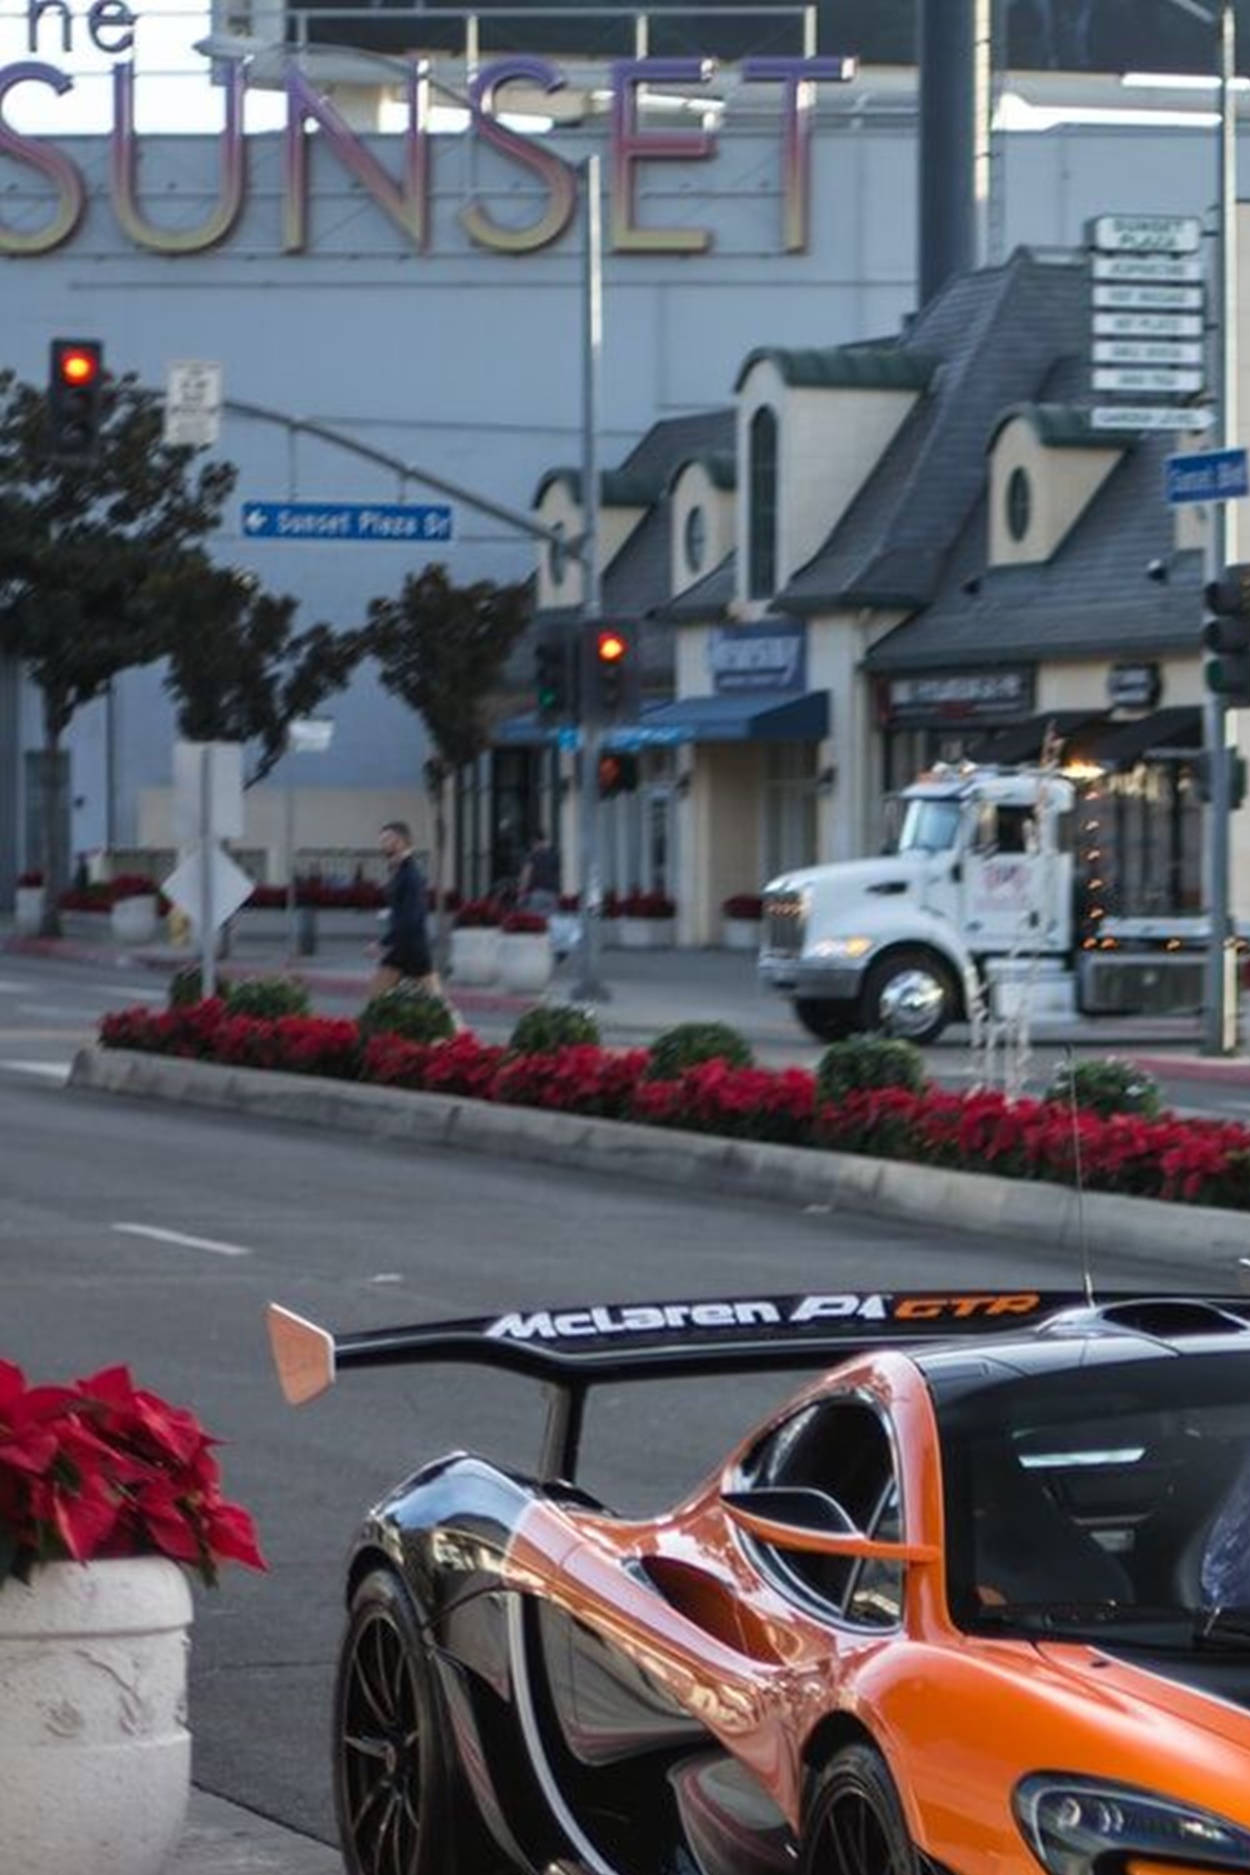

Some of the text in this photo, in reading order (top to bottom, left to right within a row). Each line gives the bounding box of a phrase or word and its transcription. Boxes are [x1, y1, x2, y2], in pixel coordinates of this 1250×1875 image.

[0, 54, 858, 256] SUNSET
[276, 508, 450, 537] Sunset Plaza Dr
[484, 1294, 1041, 1338] McLaren P1 GTR
